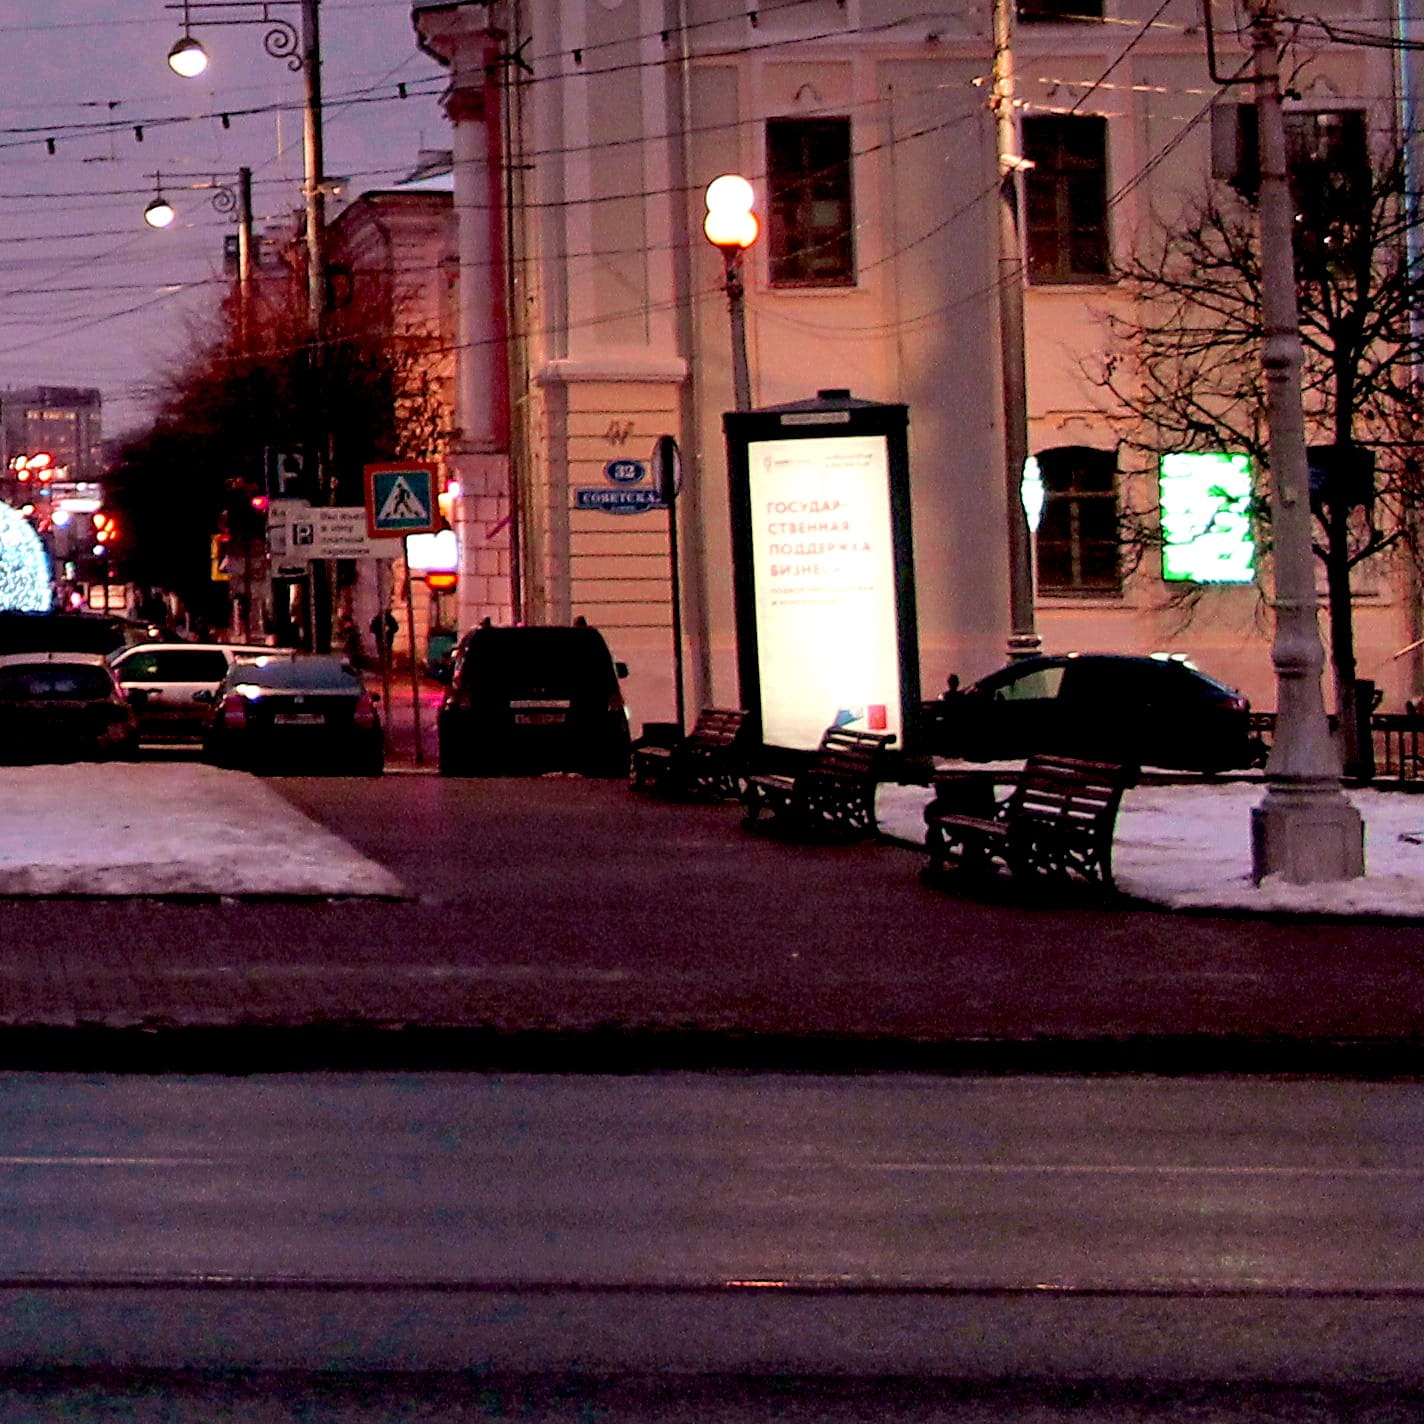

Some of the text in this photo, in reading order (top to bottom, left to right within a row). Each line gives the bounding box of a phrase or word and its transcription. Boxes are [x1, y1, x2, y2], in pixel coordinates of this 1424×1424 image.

[614, 464, 635, 479] 32
[583, 493, 661, 504] СОВЕТСКА
[767, 520, 850, 535] СТВЕННАЯ
[769, 542, 871, 555] ПОДДЕРЖКА
[770, 564, 841, 577] БИЗНЕ
